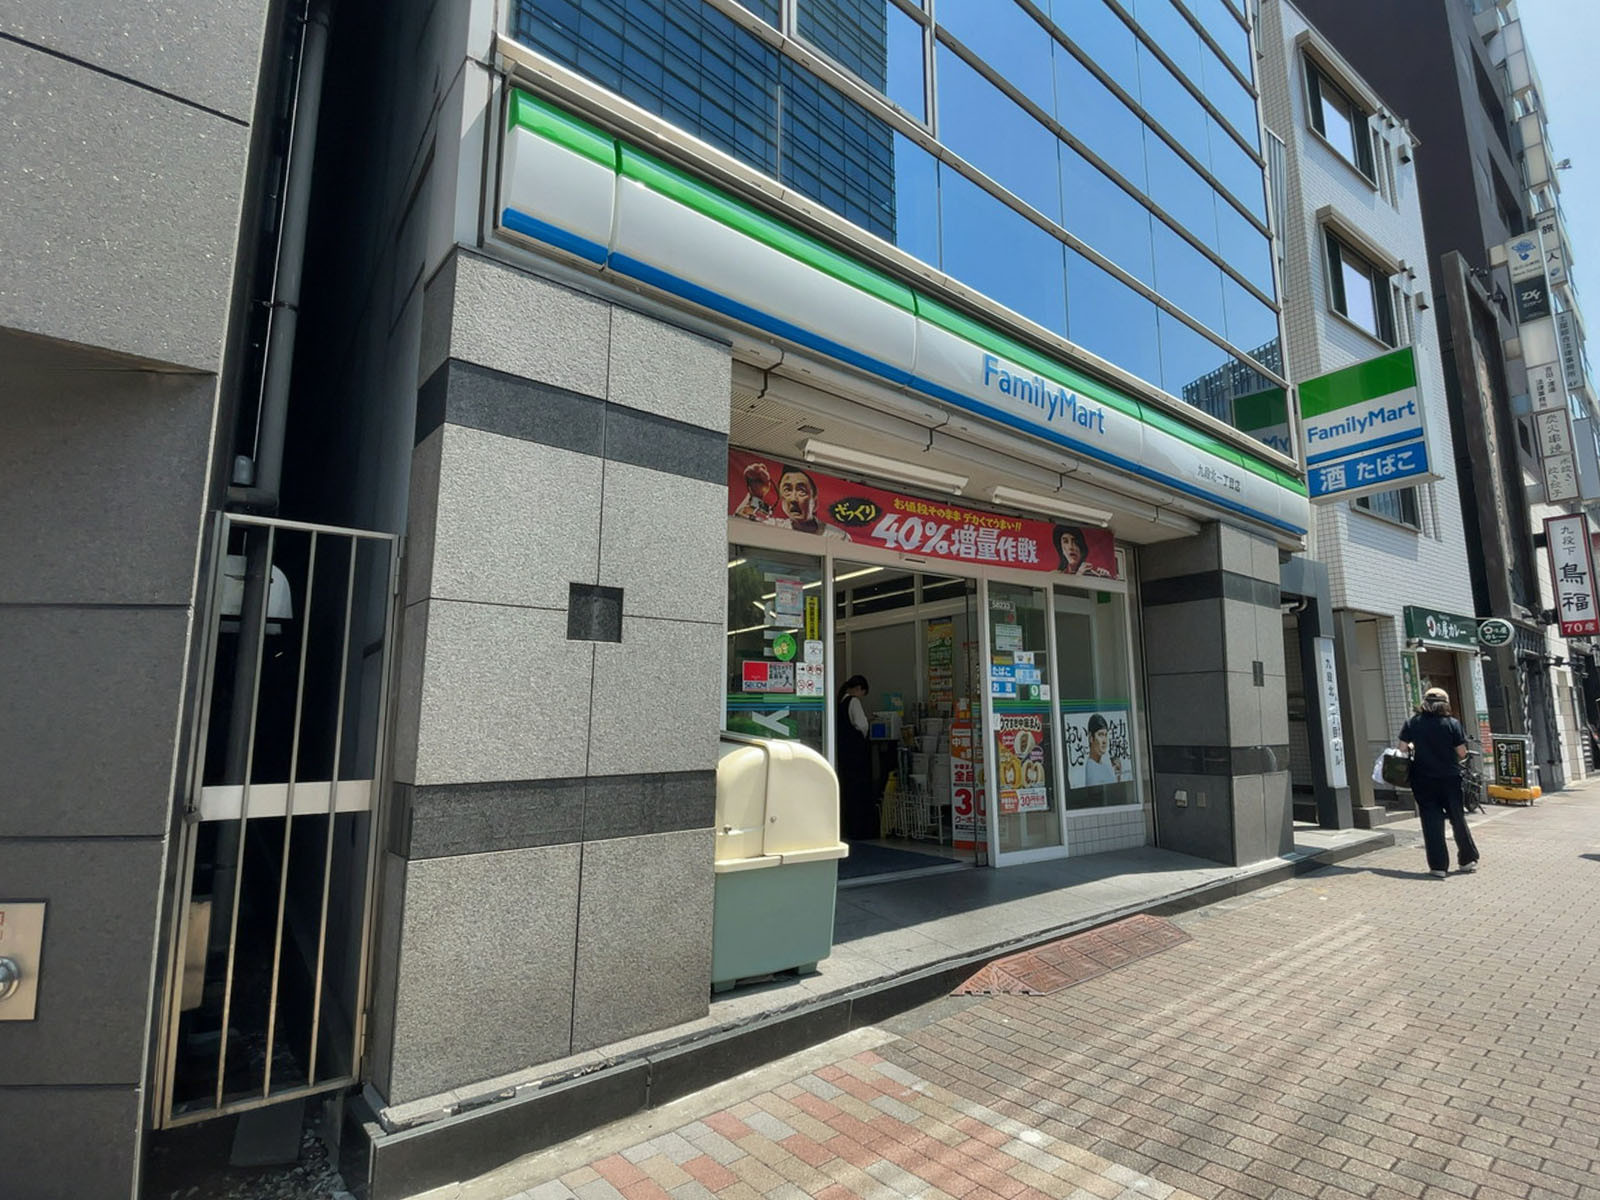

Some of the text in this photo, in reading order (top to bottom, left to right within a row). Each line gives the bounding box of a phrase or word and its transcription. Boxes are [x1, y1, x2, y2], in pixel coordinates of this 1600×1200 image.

[982, 352, 1106, 436] FamilyMart
[1307, 400, 1416, 443] FamilyMart
[1319, 451, 1416, 492] 酒 たばこ
[834, 501, 877, 522] ざっくり
[893, 498, 962, 522] お値段そのまま
[871, 513, 1040, 564] 40%増量作戦
[1560, 526, 1576, 556] 九段下
[1559, 562, 1590, 613] 鳥福
